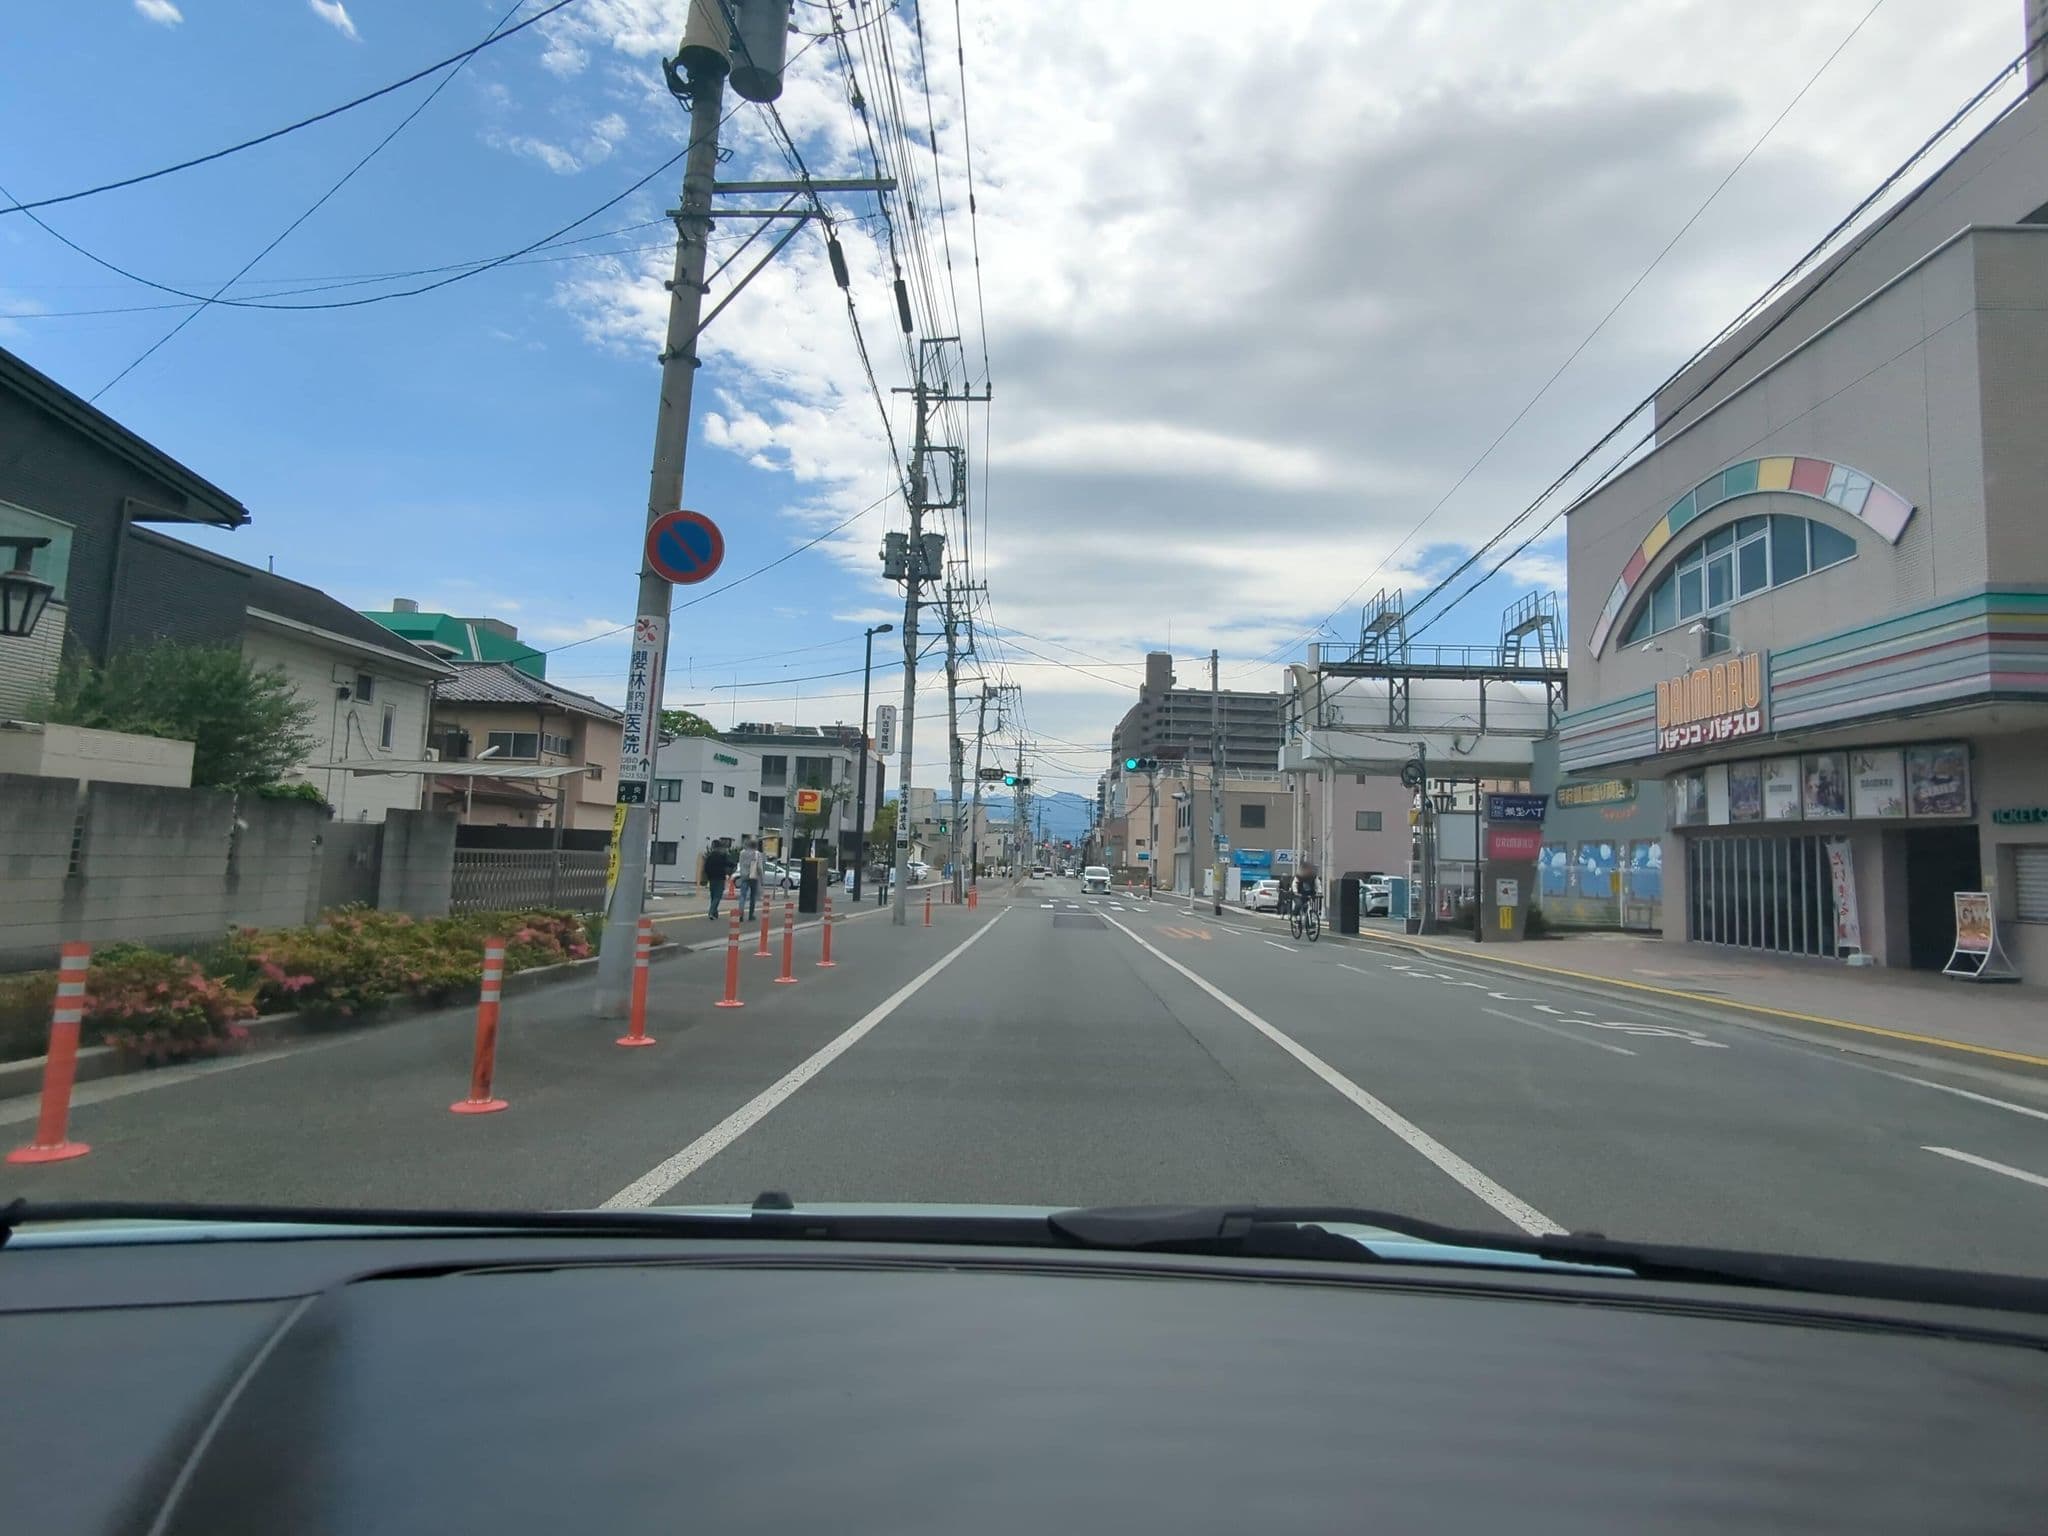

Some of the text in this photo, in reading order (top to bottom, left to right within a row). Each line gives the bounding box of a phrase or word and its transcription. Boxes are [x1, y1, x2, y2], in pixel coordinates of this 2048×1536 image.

[1656, 652, 1760, 730] DAIMARU
[1658, 710, 1761, 751] パチンコ・パチスロ
